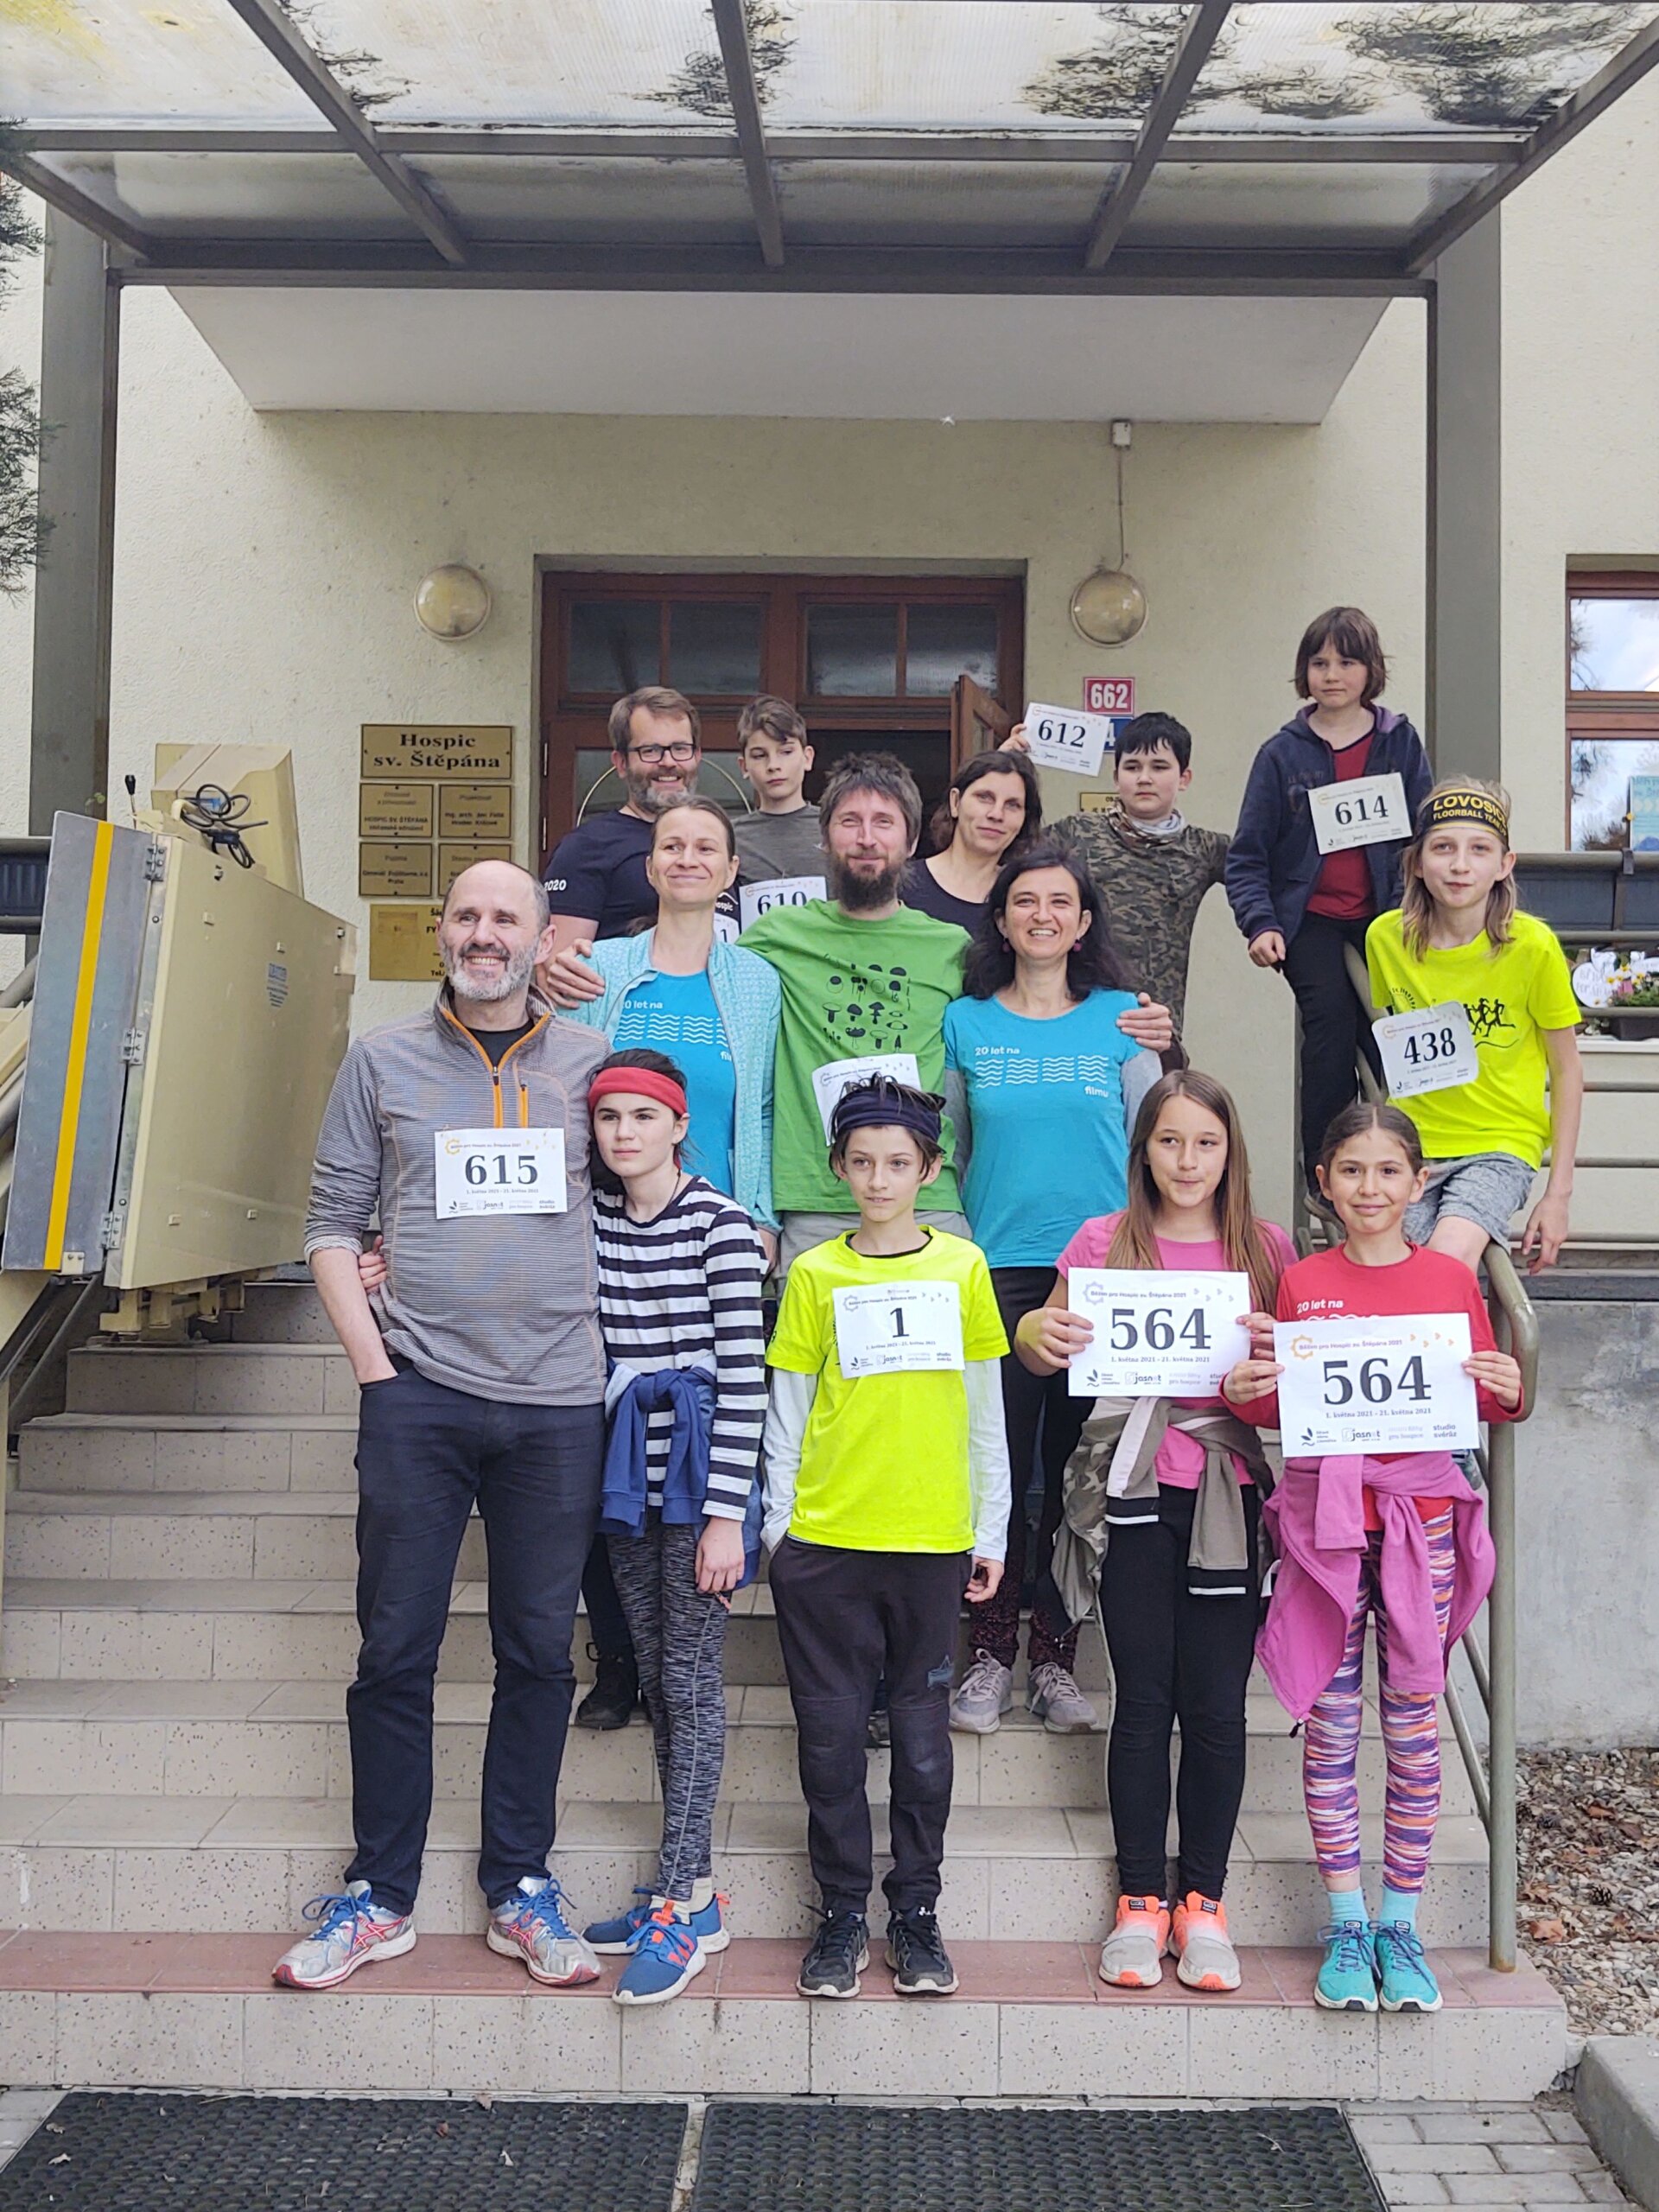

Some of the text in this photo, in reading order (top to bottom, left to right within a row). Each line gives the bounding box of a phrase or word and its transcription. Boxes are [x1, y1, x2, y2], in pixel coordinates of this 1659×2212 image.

[1090, 683, 1128, 709] 662
[400, 734, 476, 750] Hospic
[1039, 720, 1086, 748] 612
[373, 750, 500, 770] sv. Štěpána
[1335, 795, 1389, 825] 614
[1433, 809, 1484, 821] FLOORBALL
[544, 879, 567, 892] 2020
[633, 1000, 648, 1009] let
[975, 1046, 988, 1056] 20
[991, 1046, 1005, 1055] let
[1404, 1027, 1456, 1065] 438
[1084, 1085, 1109, 1098] filmu
[465, 1155, 538, 1185] 615
[1297, 1299, 1344, 1314] 20 let na
[890, 1307, 910, 1338] 1
[1110, 1308, 1211, 1351] 564
[1323, 1356, 1432, 1405] 564
